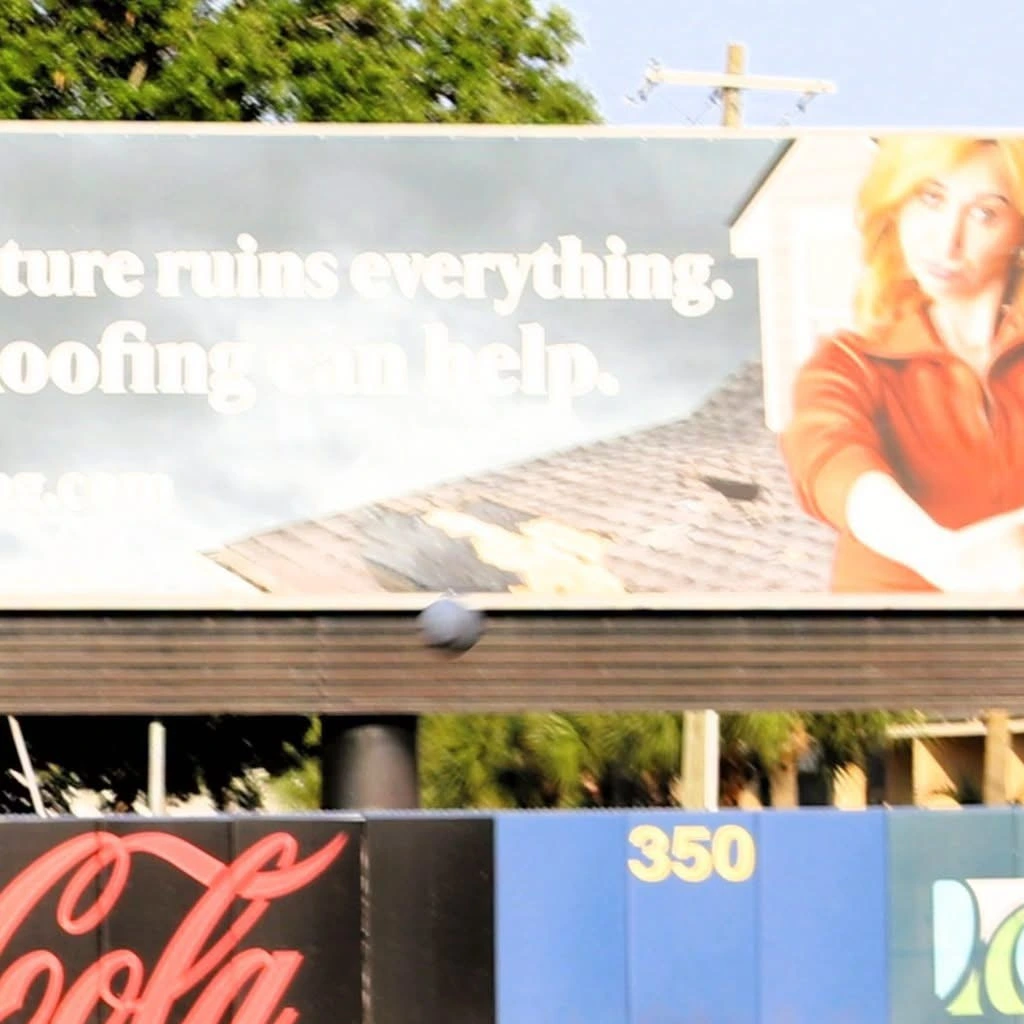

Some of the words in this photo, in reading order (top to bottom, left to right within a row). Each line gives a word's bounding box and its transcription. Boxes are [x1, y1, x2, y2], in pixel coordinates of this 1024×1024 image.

[155, 233, 339, 298] ruins
[350, 235, 734, 318] everything.
[422, 322, 620, 421] help.
[627, 825, 757, 882] 350
